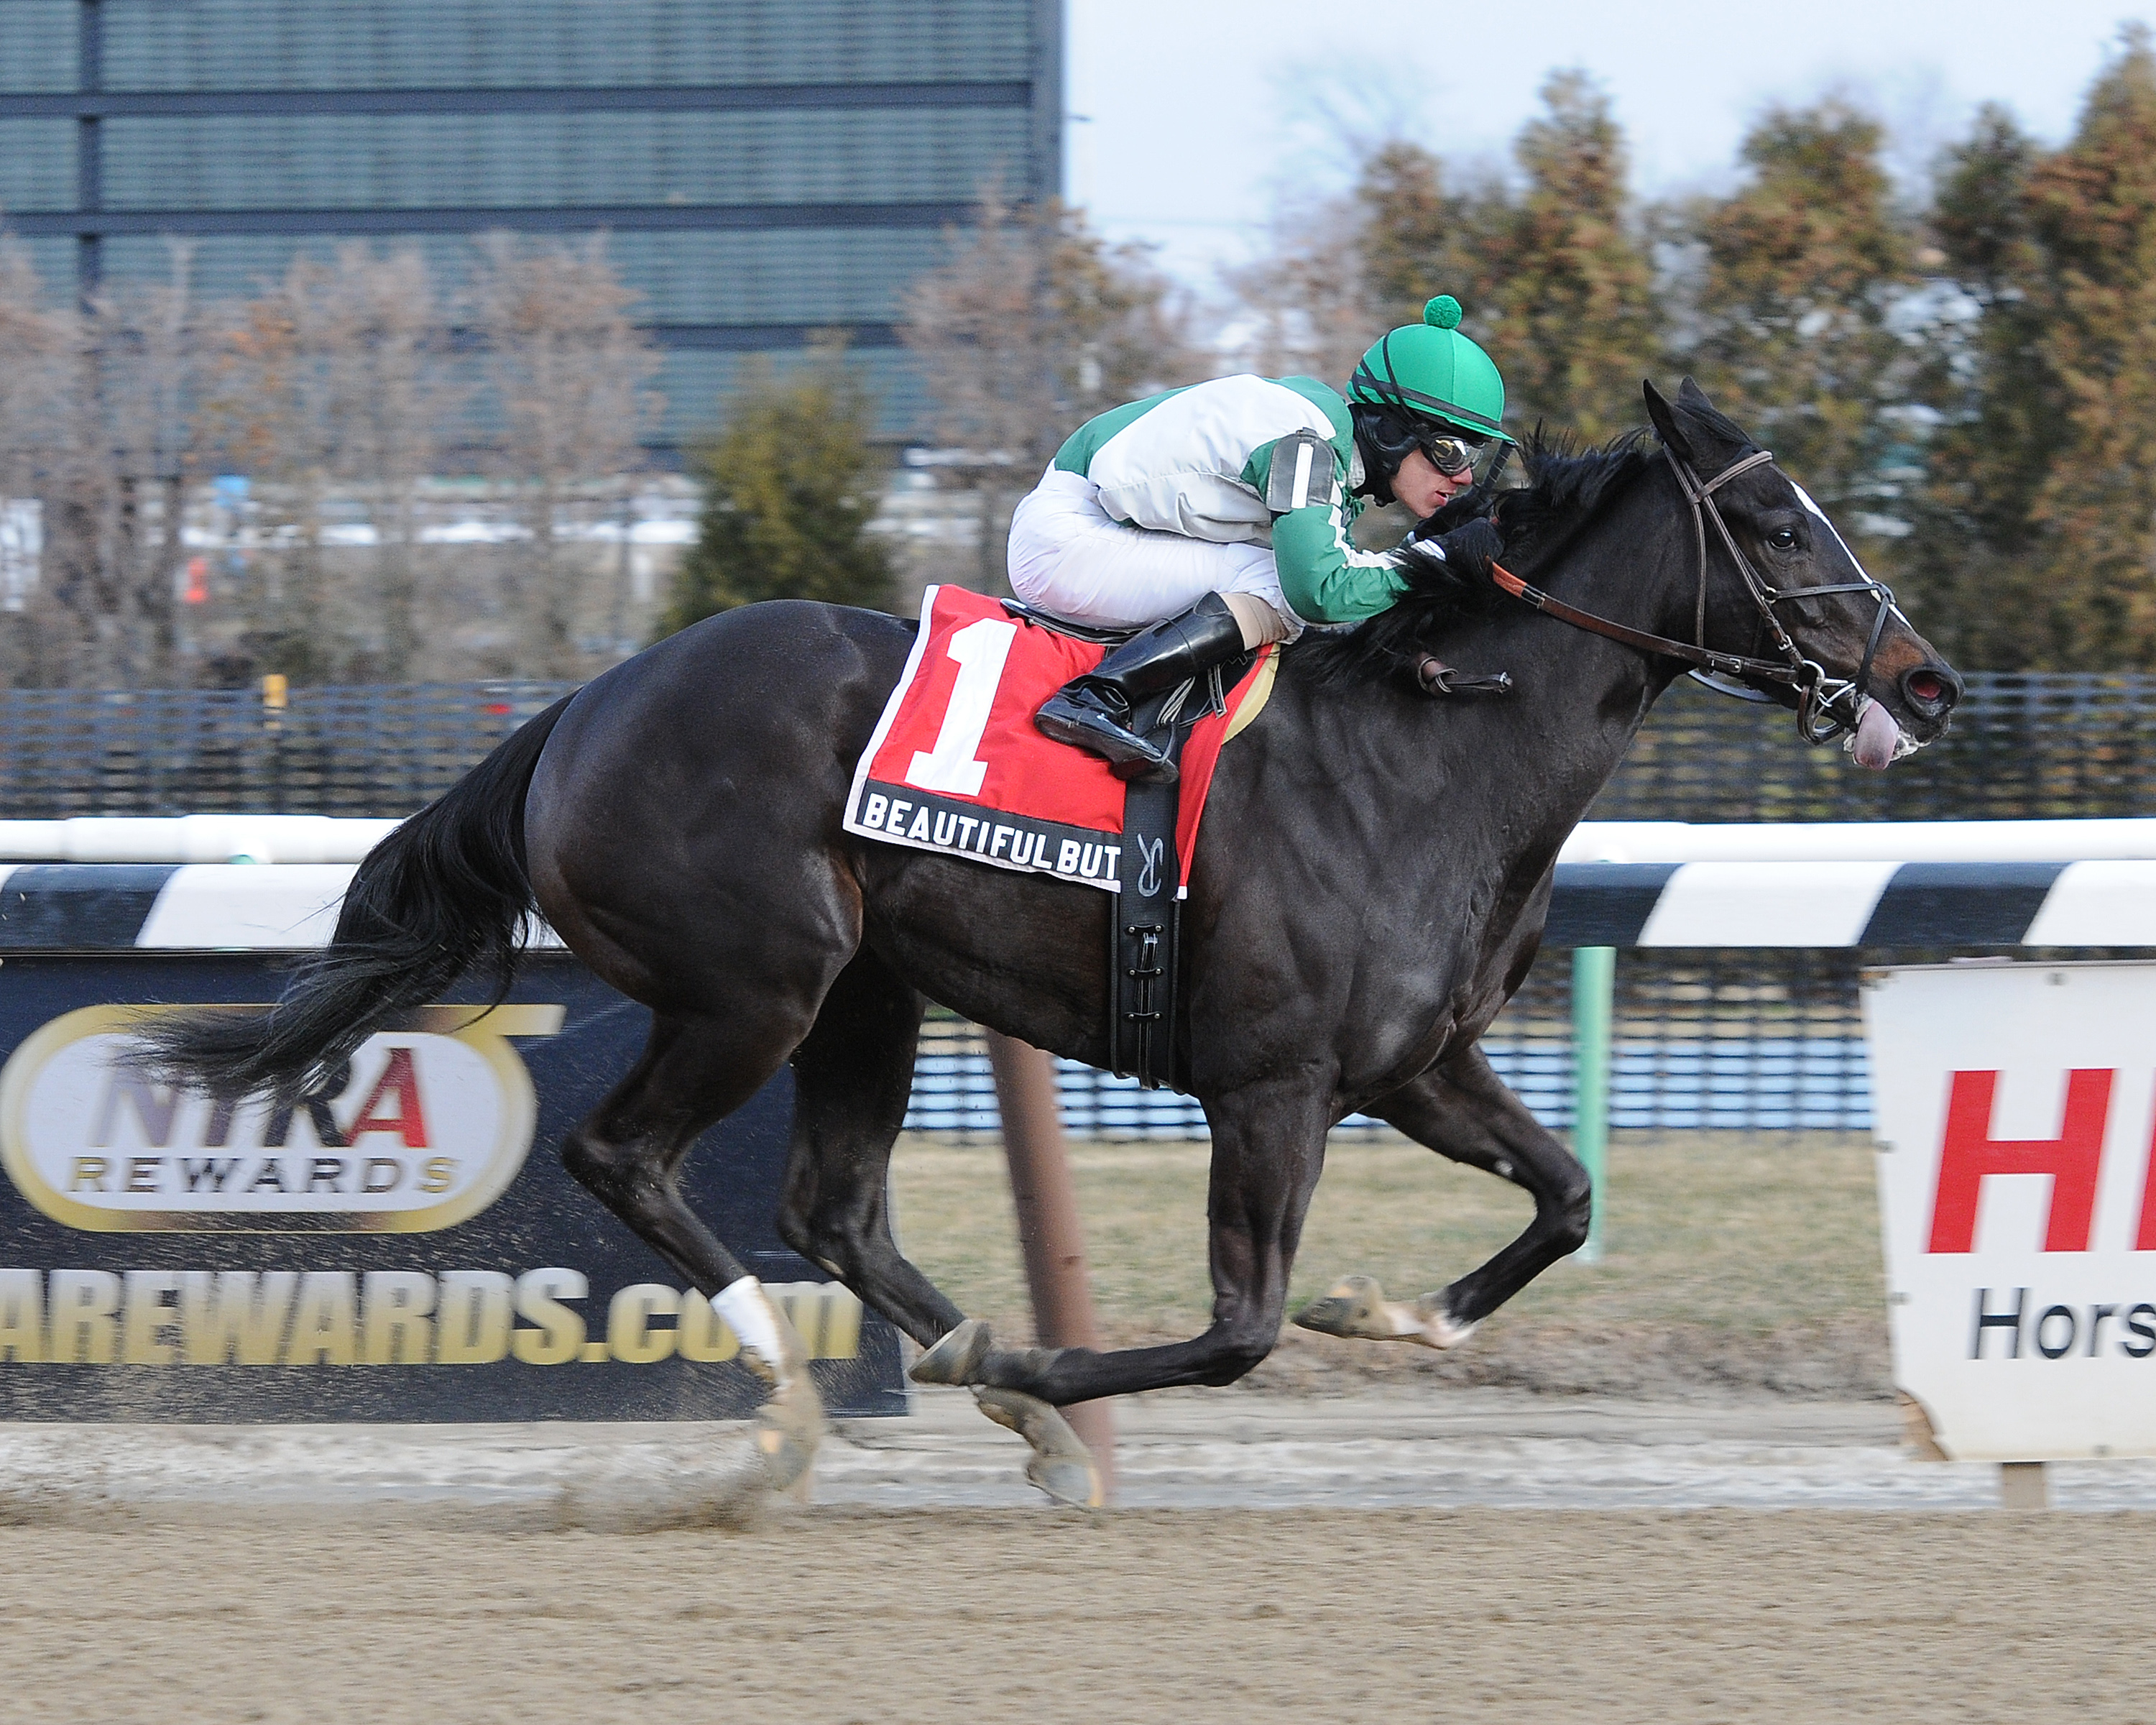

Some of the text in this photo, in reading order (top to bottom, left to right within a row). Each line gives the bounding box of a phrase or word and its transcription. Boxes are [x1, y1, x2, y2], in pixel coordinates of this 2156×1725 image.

[904, 617, 1018, 797] 1
[862, 792, 1121, 880] BEAUTIFUL BUT
[66, 1156, 460, 1194] REWARDS
[1922, 1067, 2156, 1254] H
